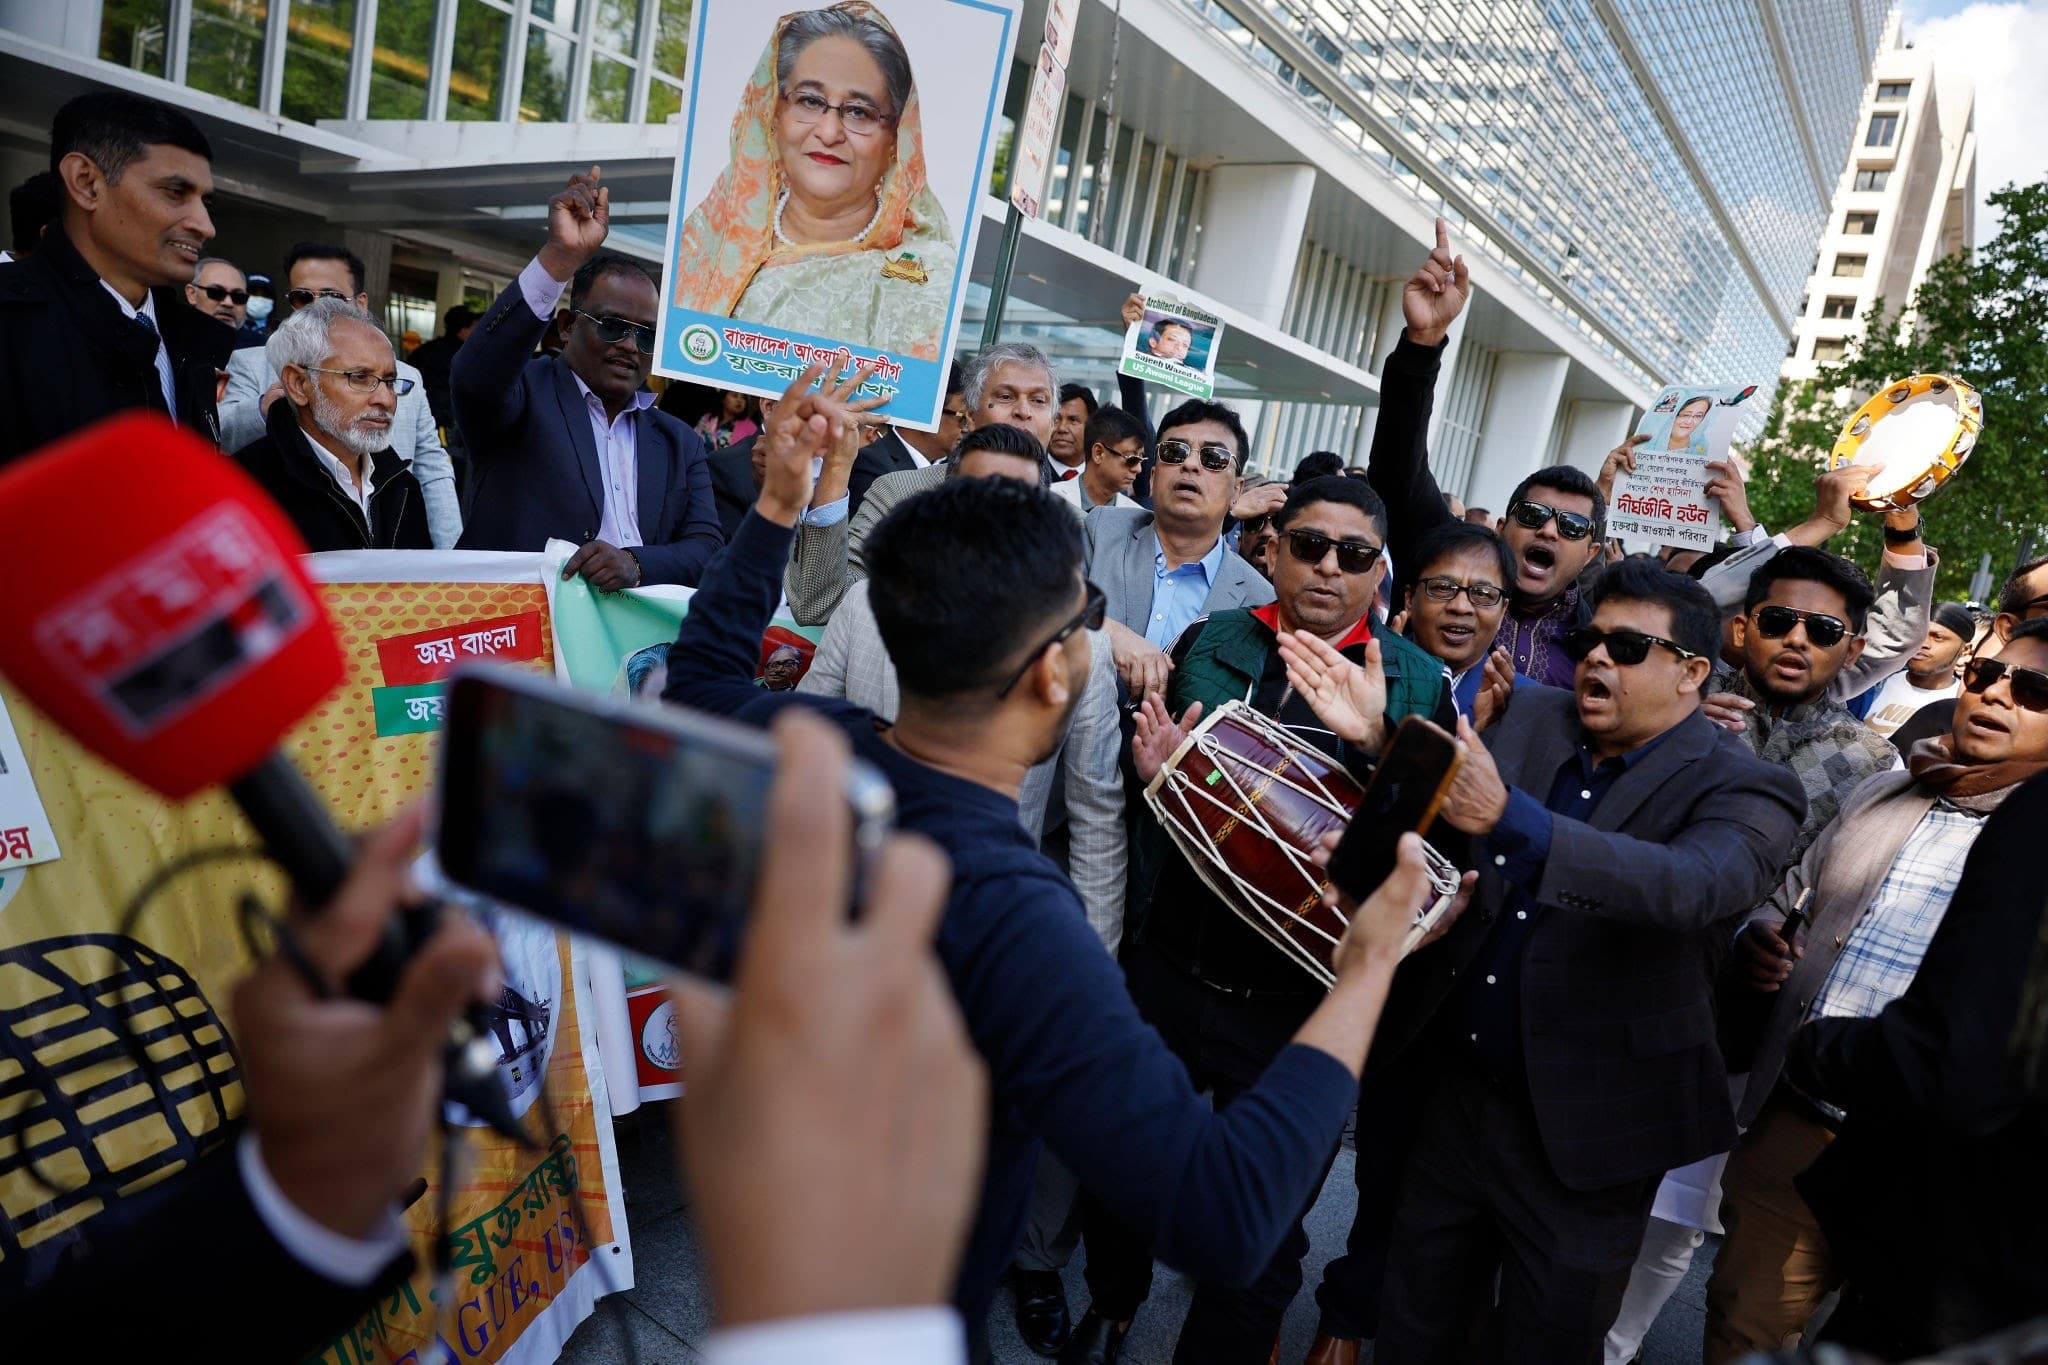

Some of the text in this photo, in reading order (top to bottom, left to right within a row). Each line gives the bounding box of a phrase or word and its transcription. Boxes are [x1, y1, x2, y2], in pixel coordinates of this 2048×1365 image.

[1146, 297, 1218, 325] Architect of Bangladesh
[724, 328, 790, 356] বাংলাদেশ
[1132, 362, 1205, 393] US Awami League
[1667, 486, 1691, 498] হাসিনা
[1617, 493, 1710, 526] দীর্ঘজীবি হউন
[1641, 524, 1676, 538] আওয়ামী
[1678, 529, 1709, 544] পরিবার
[414, 625, 517, 665] জয় বাংলা
